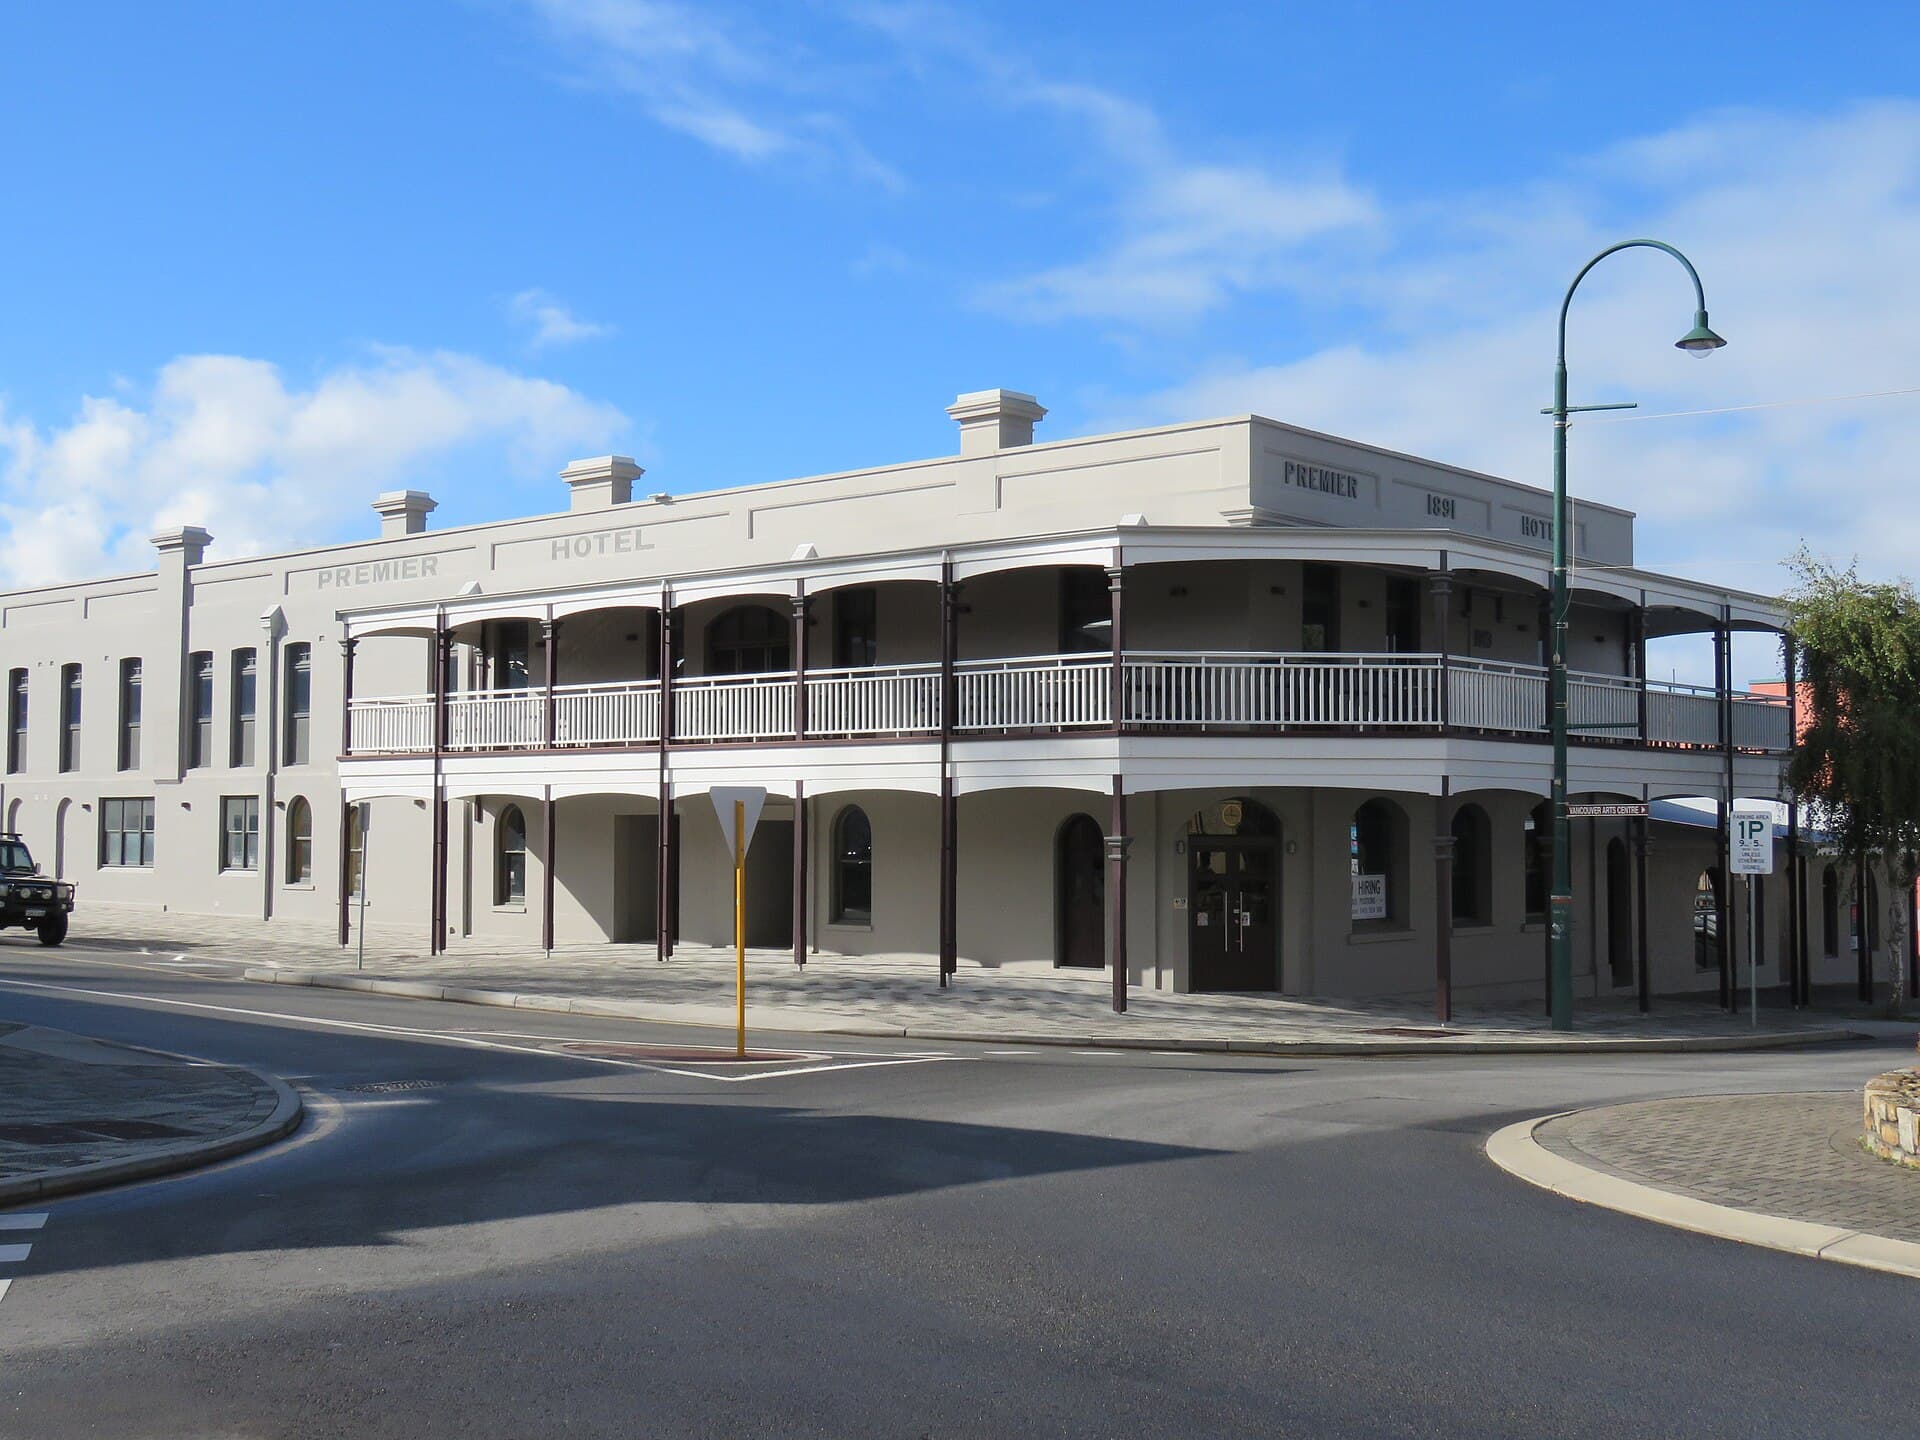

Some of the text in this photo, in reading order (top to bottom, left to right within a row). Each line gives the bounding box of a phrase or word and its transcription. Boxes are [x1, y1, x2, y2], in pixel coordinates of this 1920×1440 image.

[1285, 461, 1358, 499] PREMIER
[1427, 493, 1456, 520] 1891
[1521, 515, 1554, 541] HOTE
[552, 529, 655, 560] HOTEL
[318, 556, 439, 589] PREMIER
[1569, 805, 1639, 815] VANCOUVER ARTS CENTRE
[1738, 821, 1764, 839] 1P
[1359, 880, 1380, 895] HIRING
